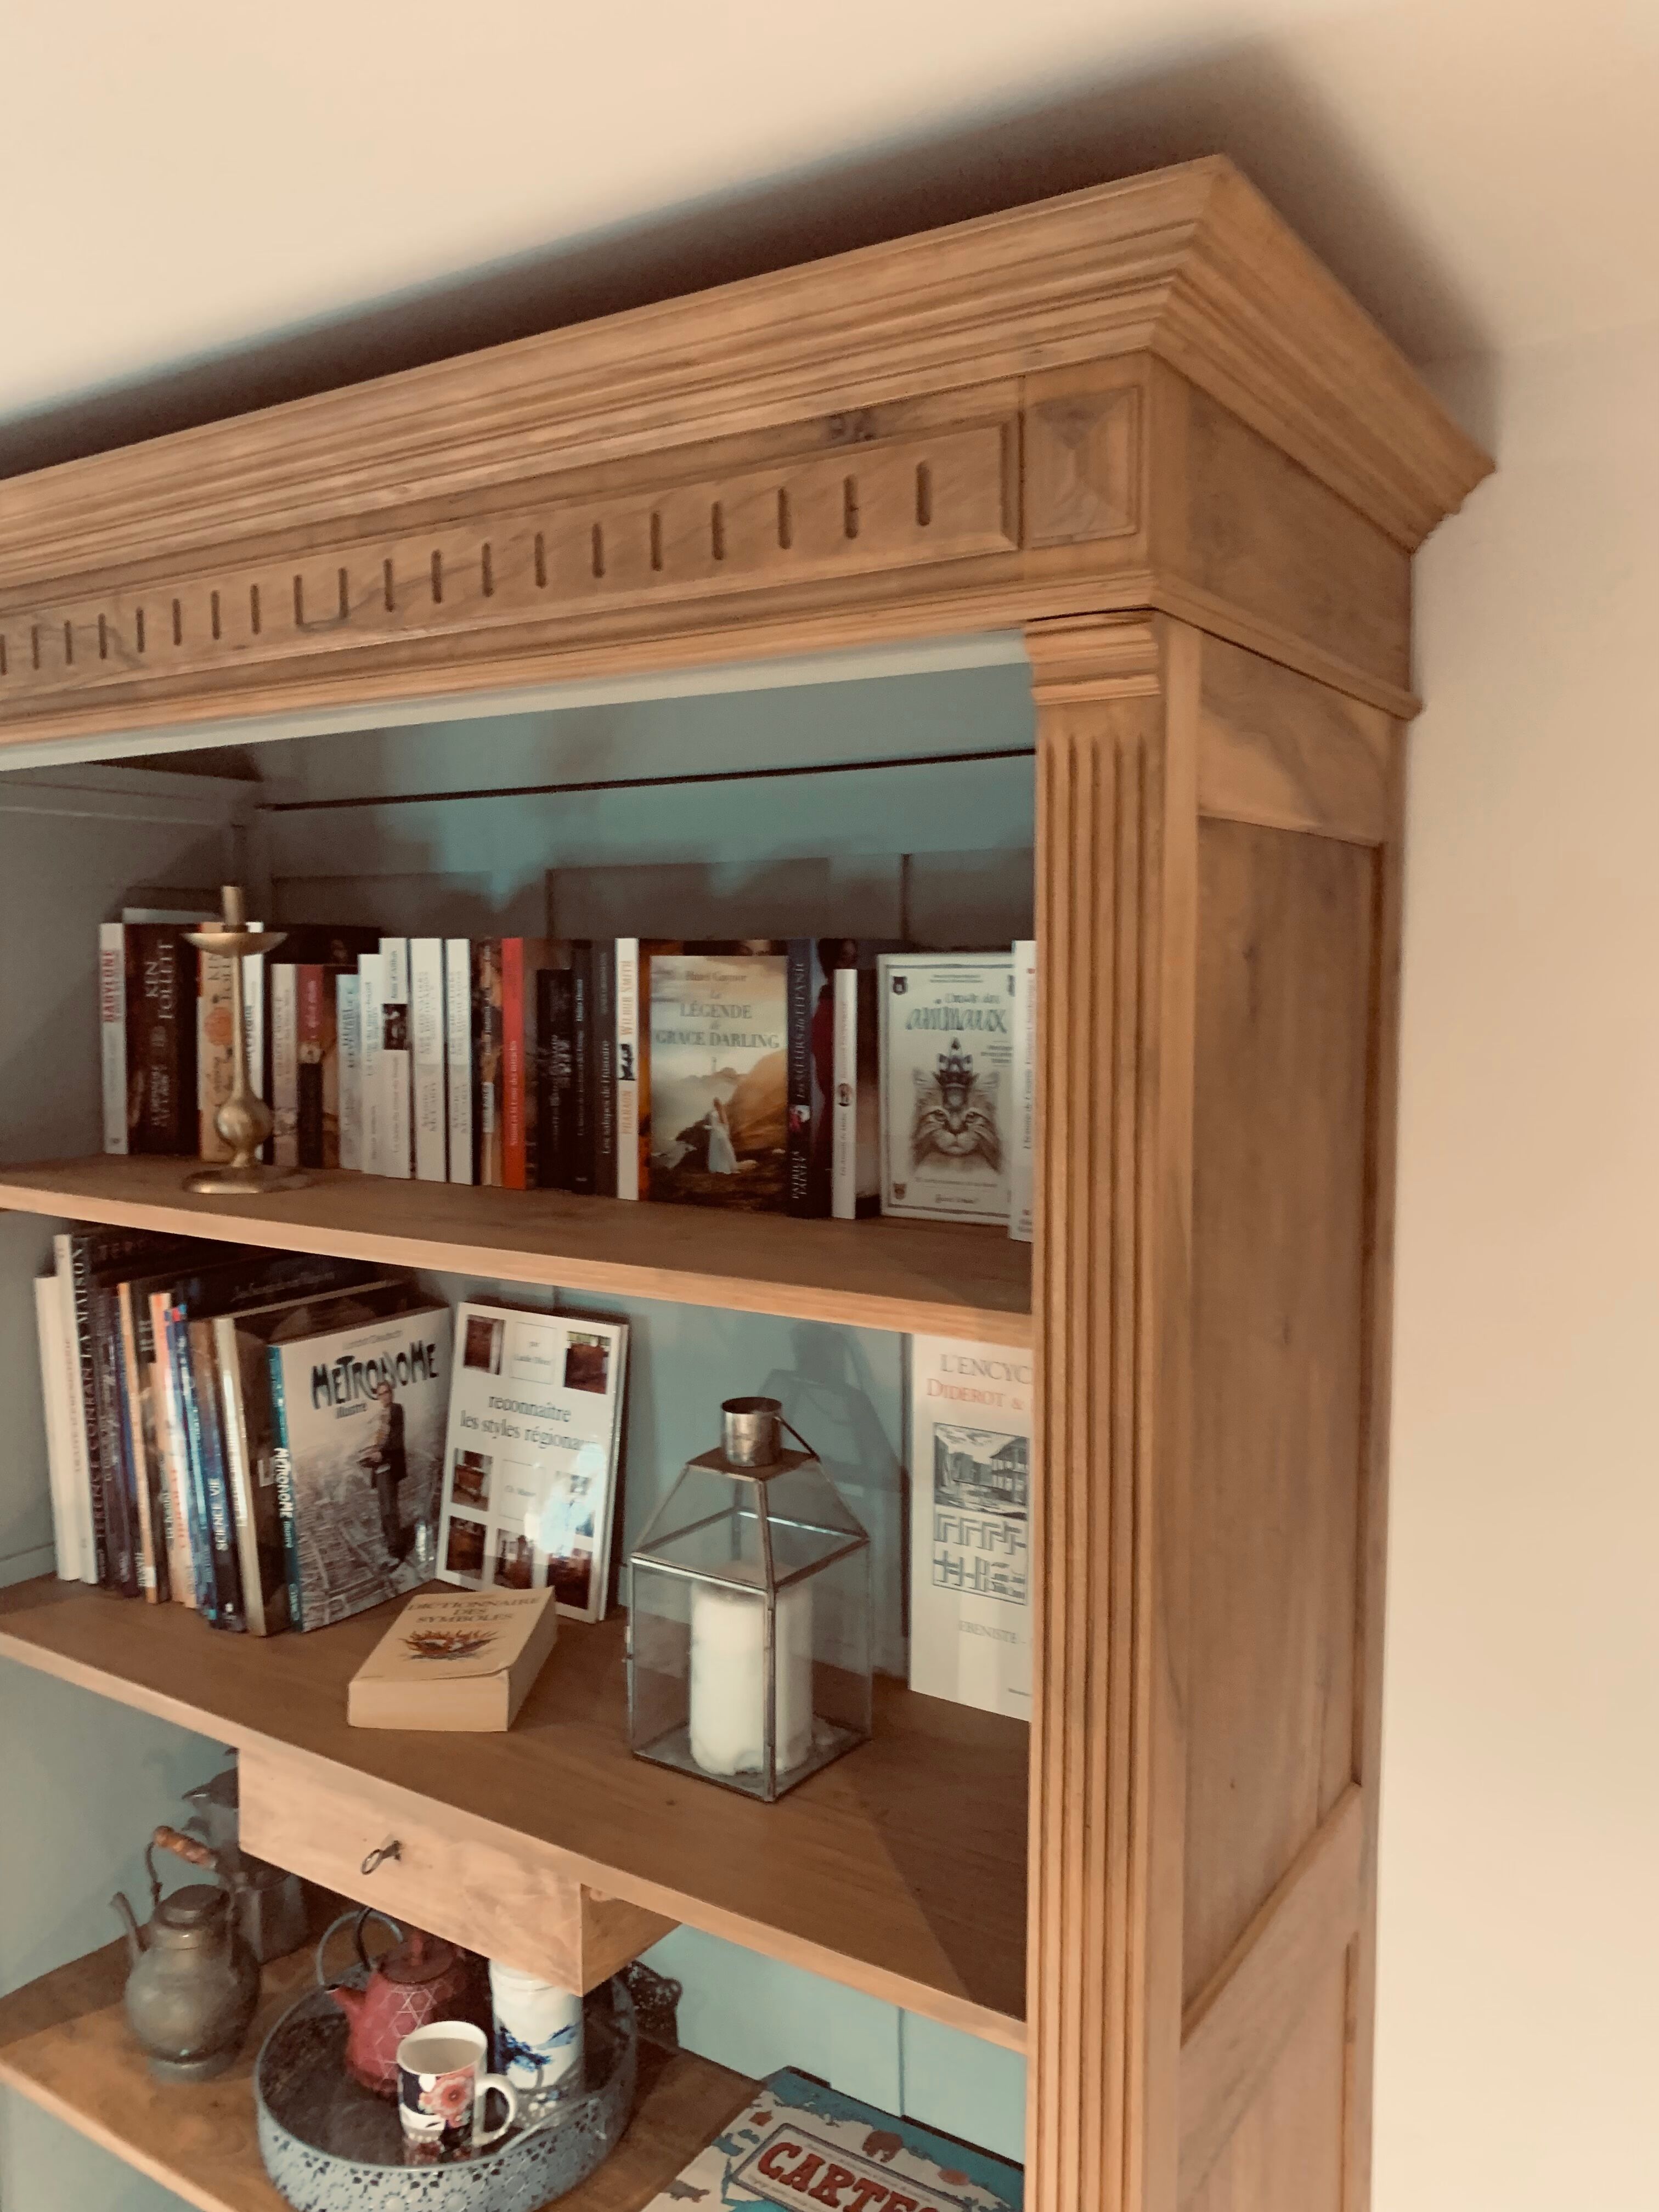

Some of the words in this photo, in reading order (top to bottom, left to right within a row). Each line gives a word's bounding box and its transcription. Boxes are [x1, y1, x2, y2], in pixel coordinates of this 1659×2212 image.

[144, 961, 158, 997] KEN
[157, 940, 174, 1019] FOLLETT
[620, 960, 632, 992] SMITH
[794, 962, 805, 1015] TITANIC
[620, 996, 633, 1036] WILBUR
[680, 1000, 752, 1019] LÉGENDE
[709, 1032, 780, 1048] DARLING
[619, 1090, 633, 1135] PHARAON
[71, 1249, 89, 1324] MAISON
[488, 1396, 572, 1423] reconnaître
[460, 1410, 479, 1430] les
[482, 1419, 521, 1439] styles
[524, 1426, 598, 1454] régiona
[408, 1597, 542, 1611] DICTIONNAIRE
[416, 1613, 514, 1623] SYMBOLES
[453, 1608, 487, 1616] DES
[758, 2142, 939, 2212] CARTE
